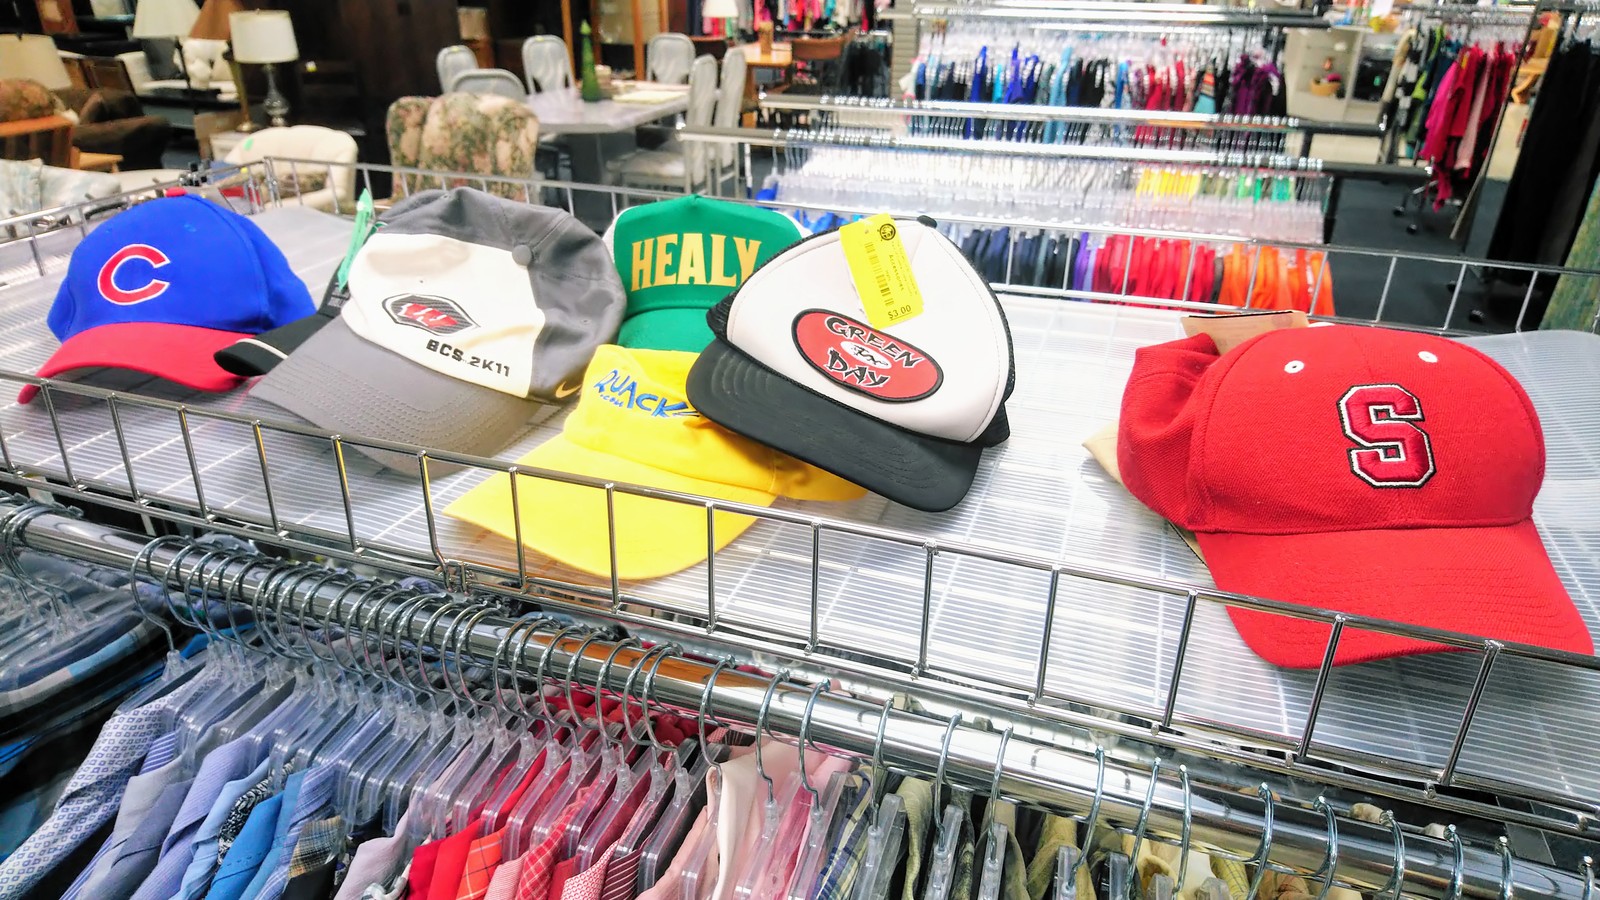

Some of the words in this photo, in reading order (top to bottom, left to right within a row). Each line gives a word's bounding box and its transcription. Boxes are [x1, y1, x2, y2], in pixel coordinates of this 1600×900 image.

[97, 243, 171, 306] C
[631, 232, 762, 292] HEALY
[887, 304, 913, 320] $3.00
[426, 338, 464, 363] BCS
[469, 355, 511, 378] 2K11
[824, 347, 891, 388] DAY
[825, 316, 925, 369] GREEN
[1336, 383, 1437, 489] S
